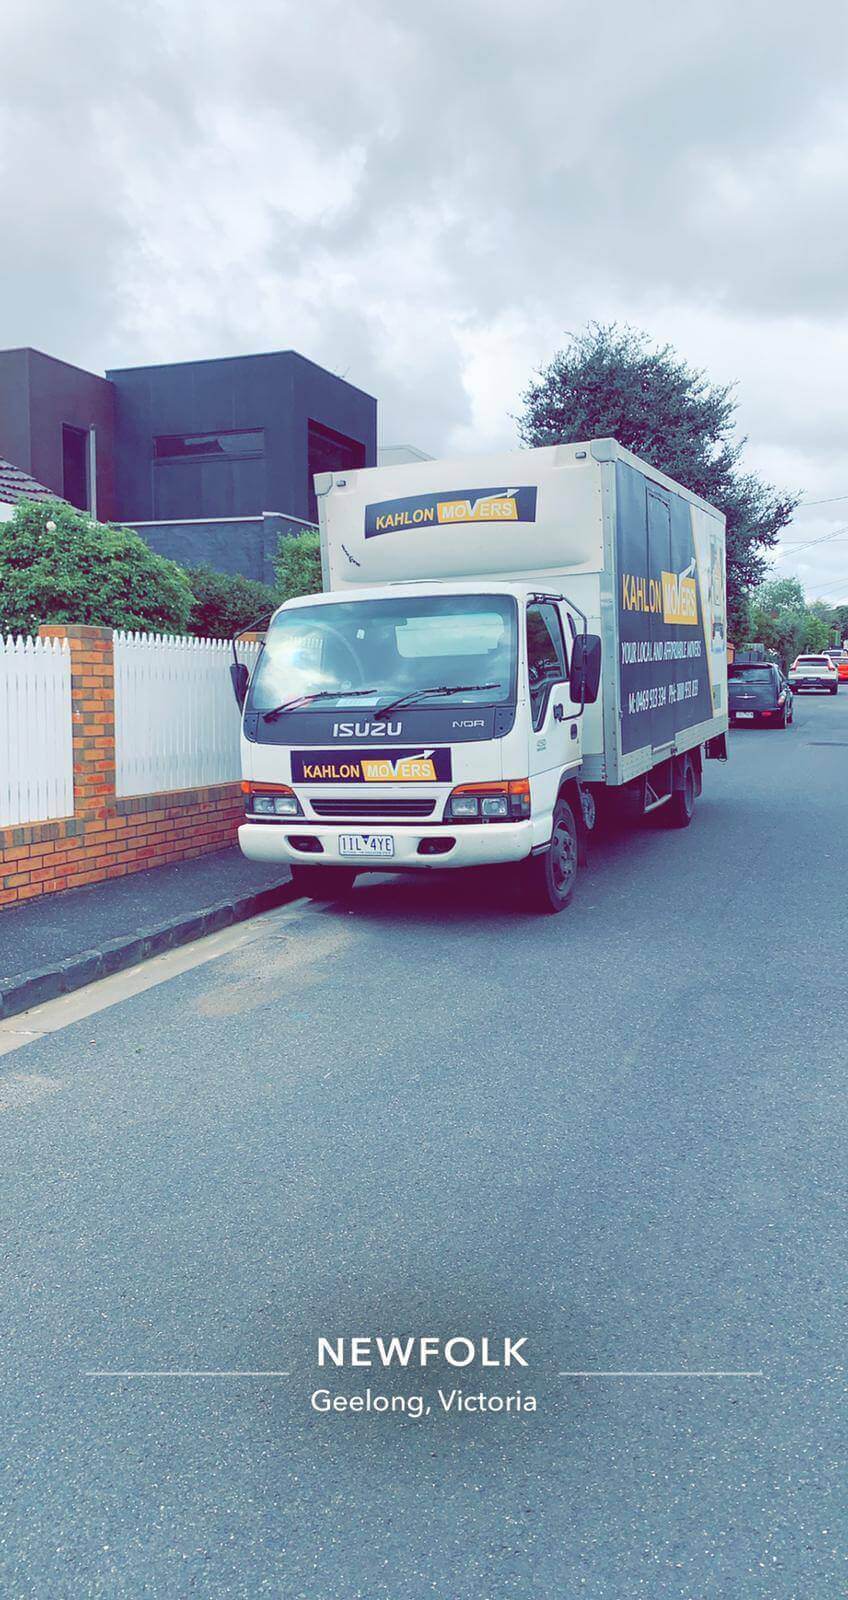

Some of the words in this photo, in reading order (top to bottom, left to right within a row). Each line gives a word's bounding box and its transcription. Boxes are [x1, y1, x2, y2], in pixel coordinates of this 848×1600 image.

[376, 507, 434, 530] KAHLON
[442, 500, 512, 519] MOVERS
[623, 574, 662, 613] KAHLON
[664, 573, 696, 616] MOVERS
[622, 641, 636, 664] YOUR
[637, 641, 653, 662] LOCAL
[333, 722, 402, 737] ISUZU
[303, 764, 360, 779] KAHLON
[366, 760, 432, 777] MOVERS
